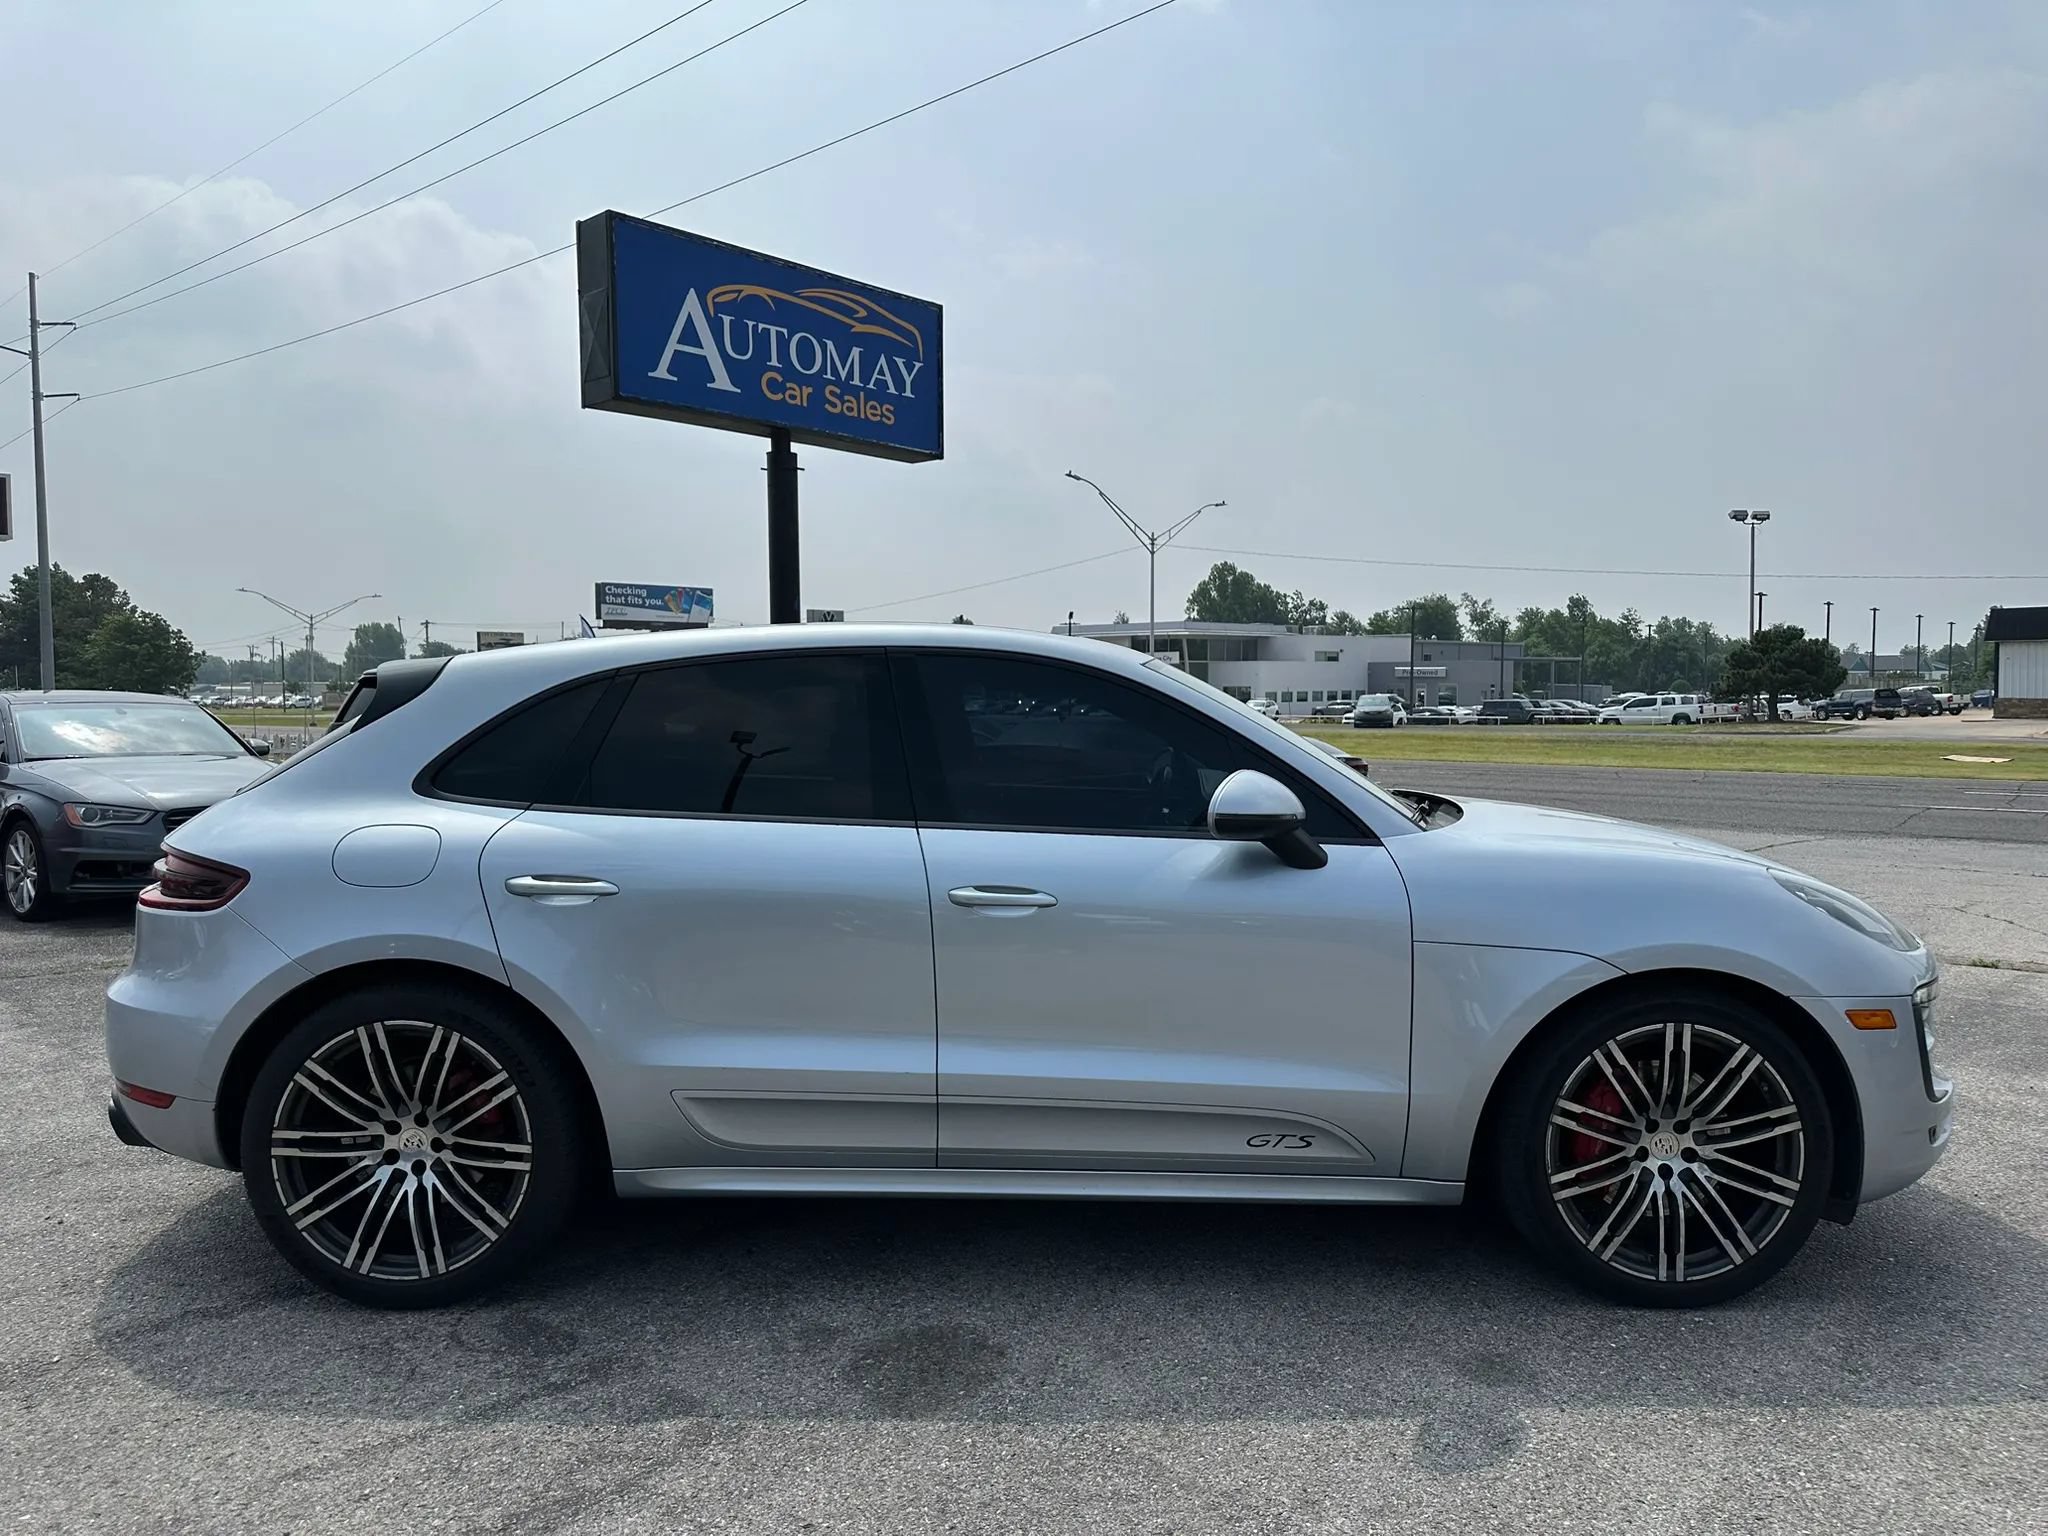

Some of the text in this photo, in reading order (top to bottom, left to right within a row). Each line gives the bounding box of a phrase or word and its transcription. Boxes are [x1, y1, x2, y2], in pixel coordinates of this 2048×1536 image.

[648, 287, 923, 398] AUTOMAY
[761, 371, 895, 425] Car Sales
[605, 585, 647, 597] Checking
[605, 594, 626, 604] that
[1246, 1133, 1316, 1149] GTS
